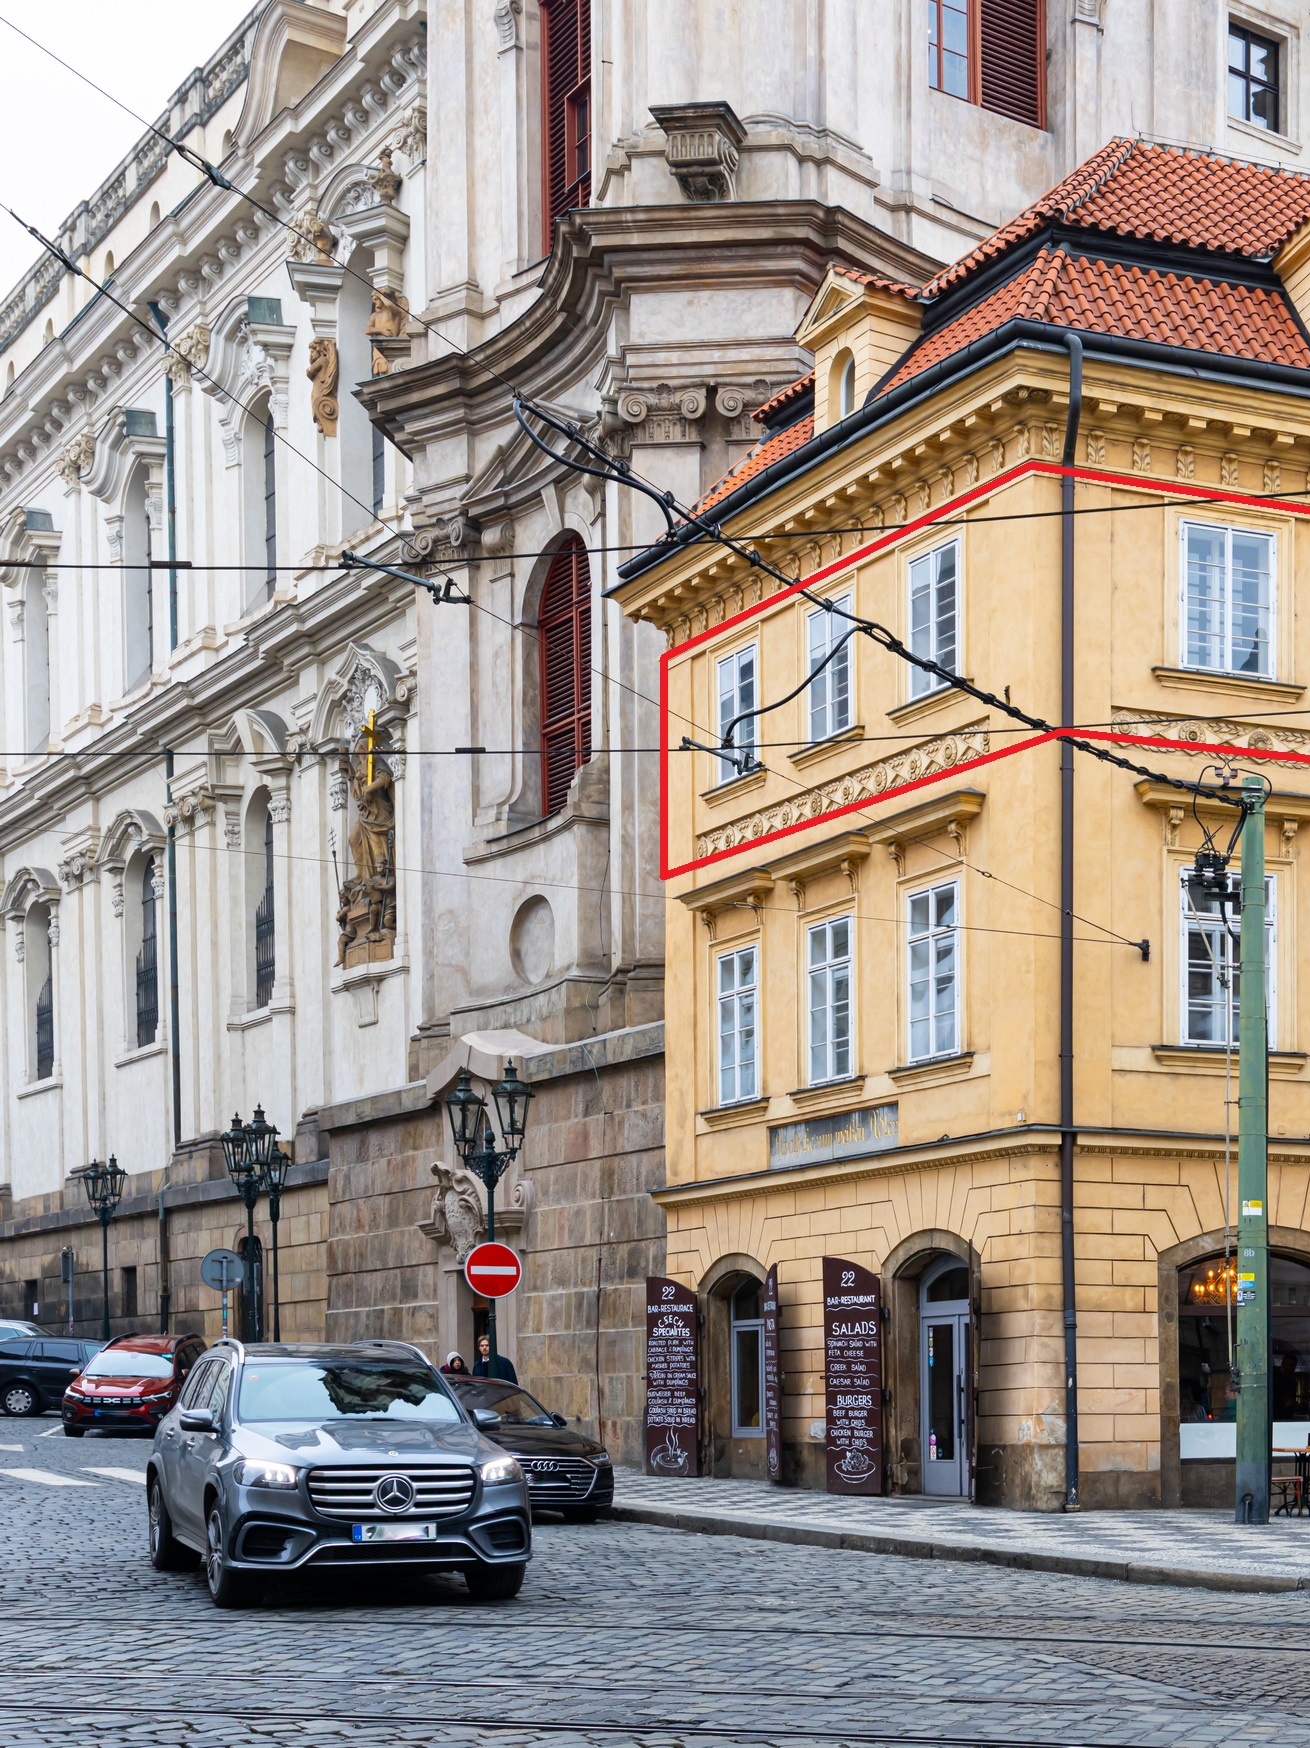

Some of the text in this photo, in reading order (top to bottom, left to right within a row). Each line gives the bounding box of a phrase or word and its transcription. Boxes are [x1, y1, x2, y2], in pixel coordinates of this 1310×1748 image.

[841, 1271, 855, 1287] 22
[662, 1286, 676, 1300] 22
[827, 1295, 876, 1305] BAR-RESTAURANT
[648, 1304, 693, 1313] BAR-RESTAURACE
[832, 1321, 877, 1335] SALADS
[837, 1395, 872, 1405] BURGERS
[854, 1430, 873, 1438] BURGER
